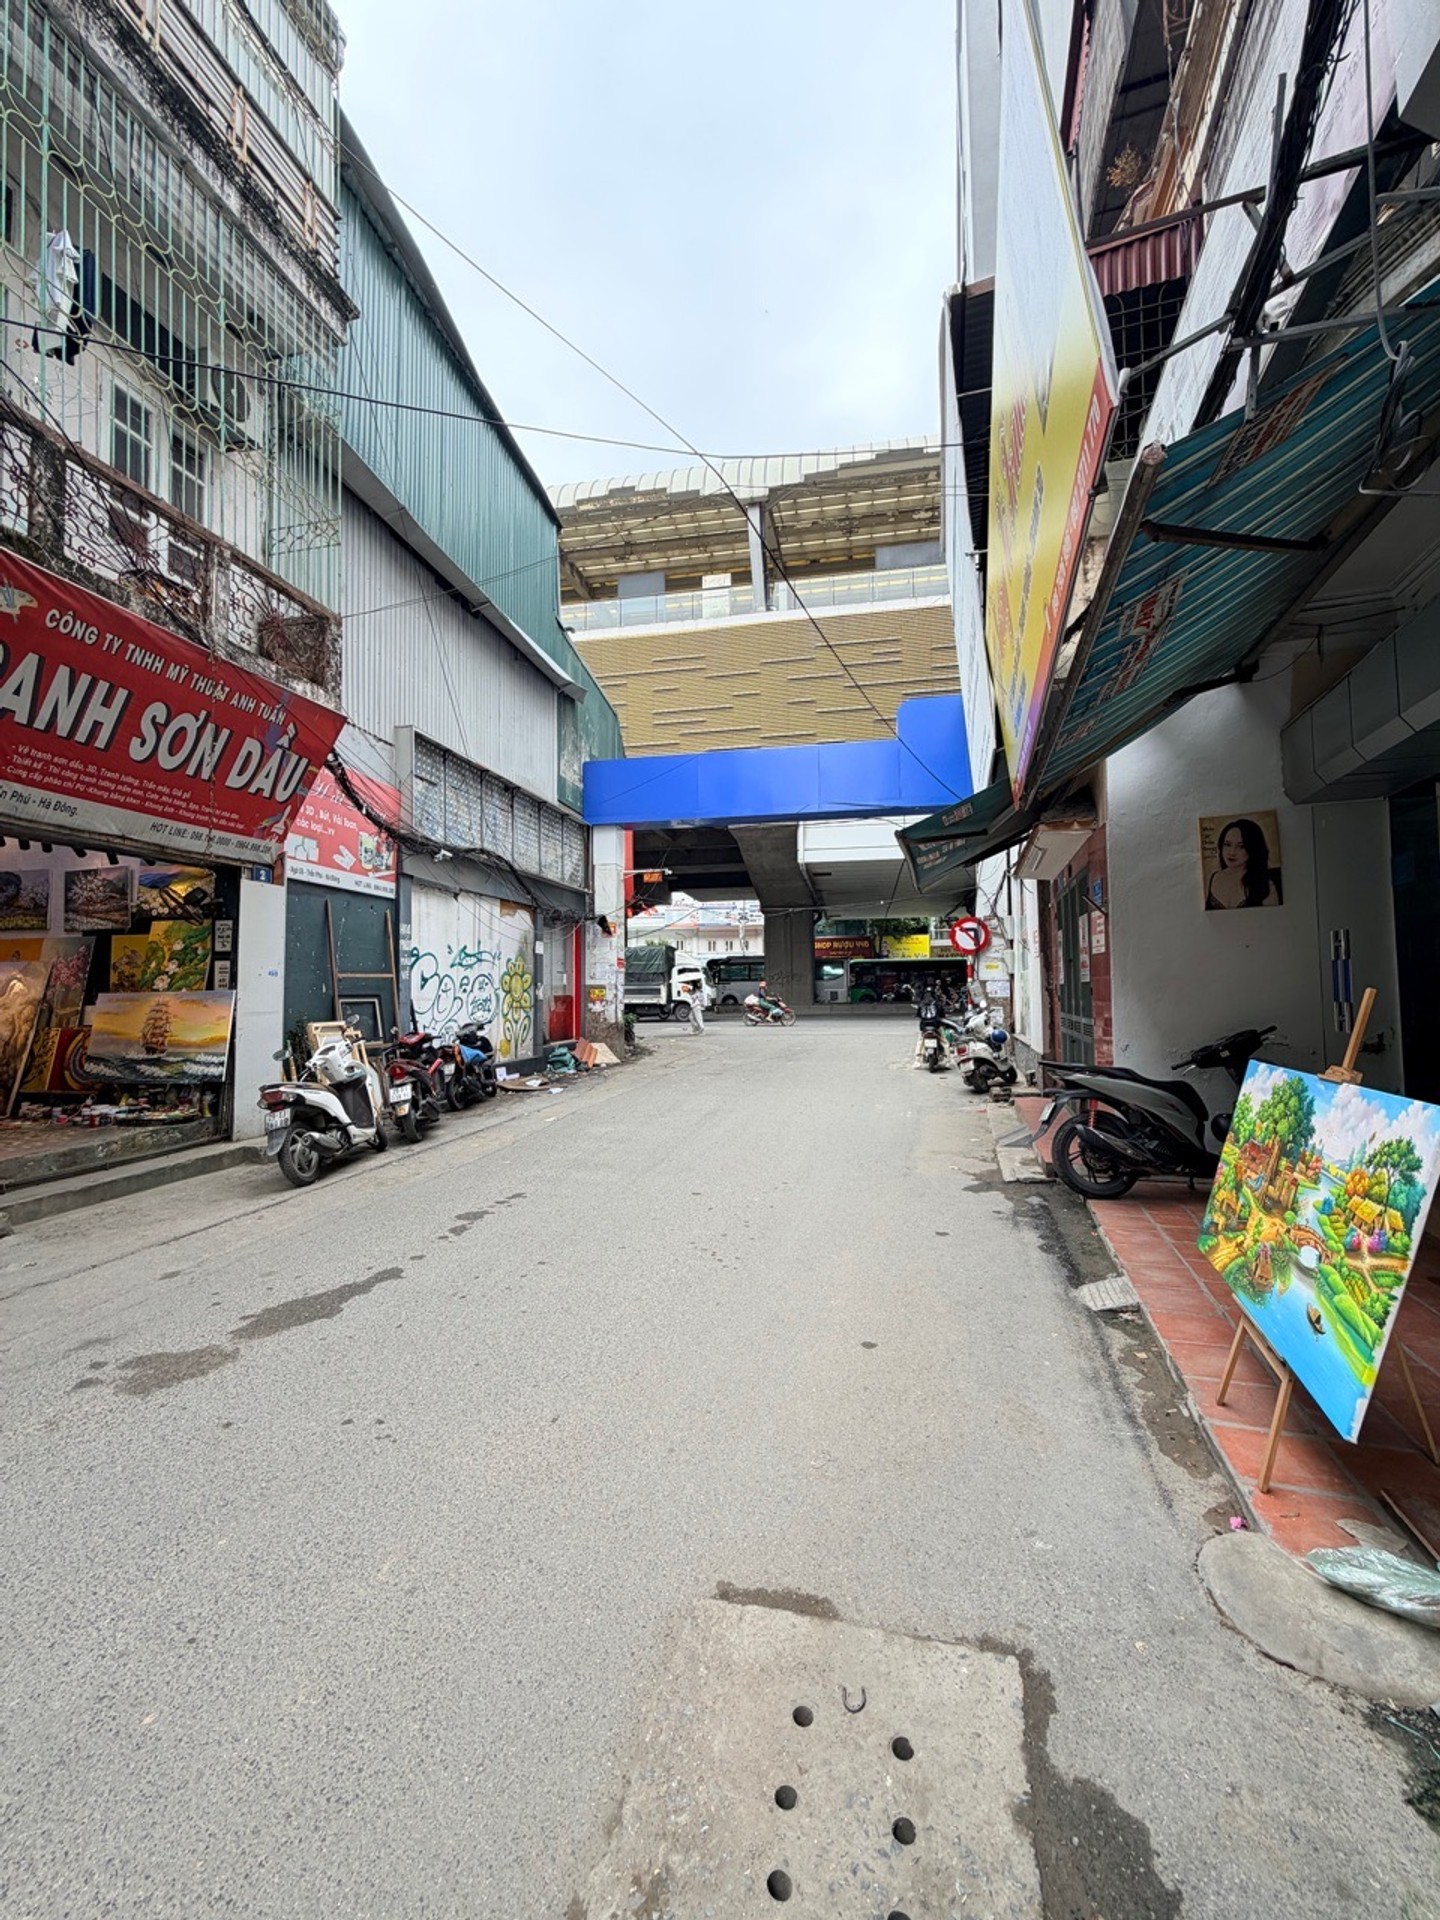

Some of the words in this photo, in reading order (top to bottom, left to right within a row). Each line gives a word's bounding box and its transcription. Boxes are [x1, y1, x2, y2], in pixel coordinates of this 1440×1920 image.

[45, 609, 98, 645] CÔNG
[102, 633, 123, 655] TY
[124, 643, 165, 675] TNHH
[166, 663, 189, 684] MỸ
[190, 673, 230, 703] THUẬT
[230, 692, 257, 713] ANH
[257, 703, 286, 725] TUẤN
[0, 645, 130, 749] ANH
[129, 702, 232, 782] SƠN
[225, 722, 310, 802] DẦU
[10, 790, 31, 805] Phú
[38, 797, 52, 809] Hà
[53, 801, 78, 817] Đông.
[150, 822, 168, 834] HOT
[260, 869, 266, 880] 2
